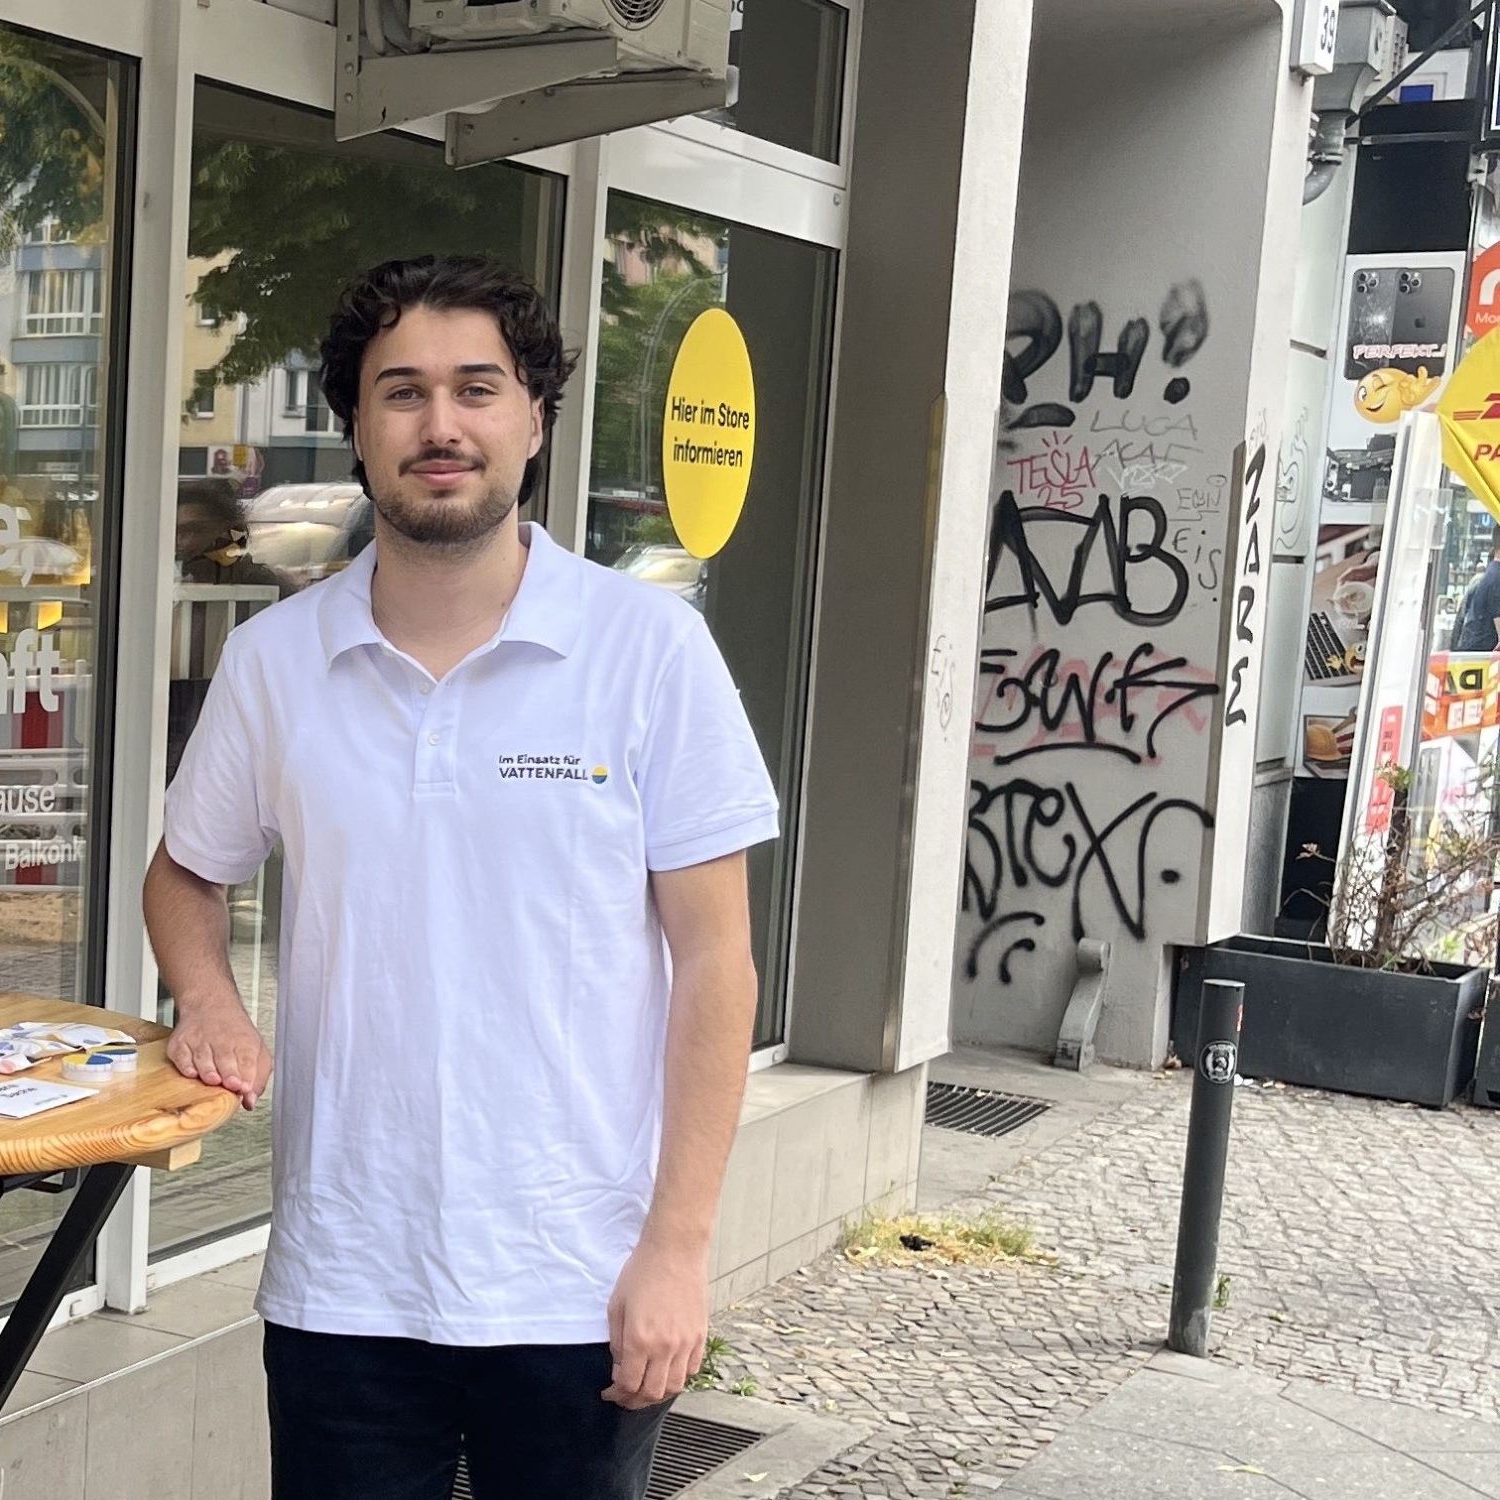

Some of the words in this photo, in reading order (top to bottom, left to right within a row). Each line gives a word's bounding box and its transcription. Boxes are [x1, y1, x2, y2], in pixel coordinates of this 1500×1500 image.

[671, 396, 698, 424] Hier
[700, 400, 715, 425] im
[718, 402, 750, 430] Store
[673, 436, 743, 467] informieren
[517, 754, 561, 765] Einsatz
[563, 755, 581, 765] für
[499, 767, 589, 781] VATTENFALL
